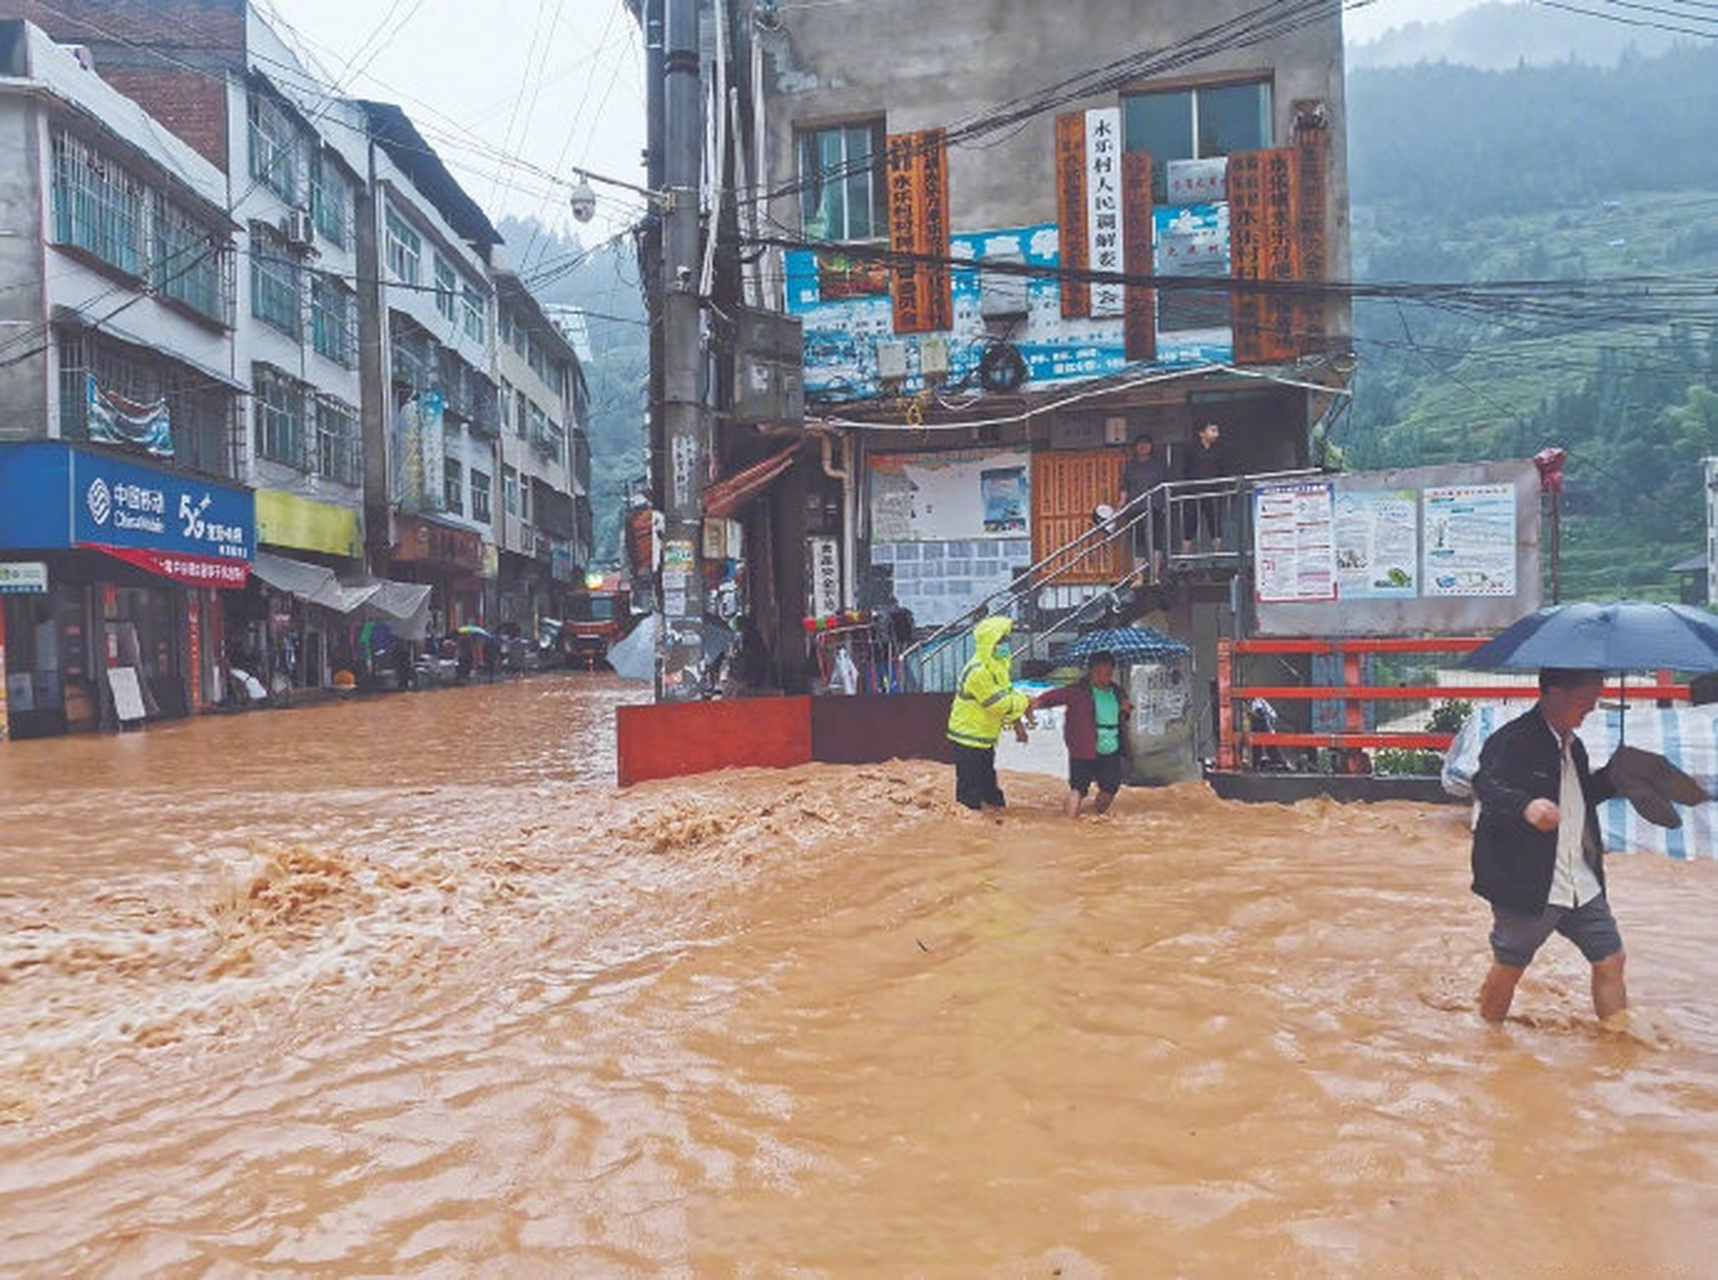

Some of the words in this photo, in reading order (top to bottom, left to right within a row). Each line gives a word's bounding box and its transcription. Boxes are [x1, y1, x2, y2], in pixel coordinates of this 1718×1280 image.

[1093, 118, 1119, 306] 永乐村人民调解委会
